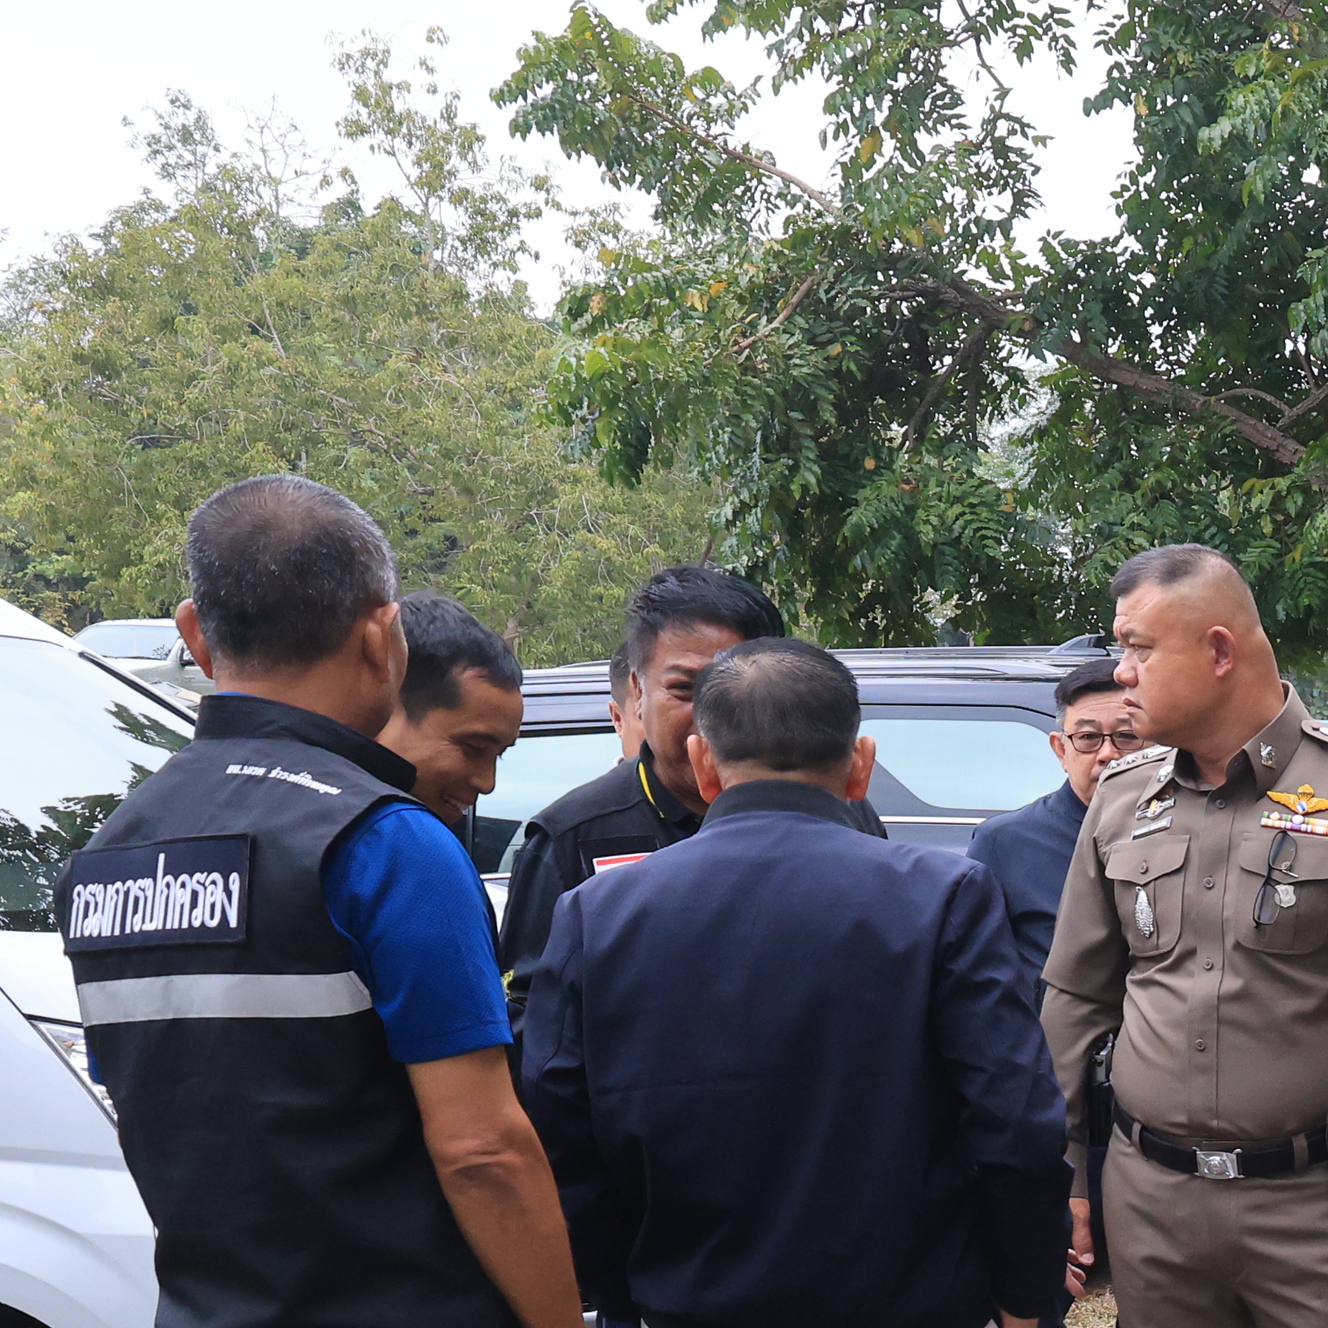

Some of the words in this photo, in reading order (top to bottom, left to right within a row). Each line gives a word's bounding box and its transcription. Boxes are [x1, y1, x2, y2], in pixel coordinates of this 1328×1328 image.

[69, 853, 240, 939] กรมการปกครอง
